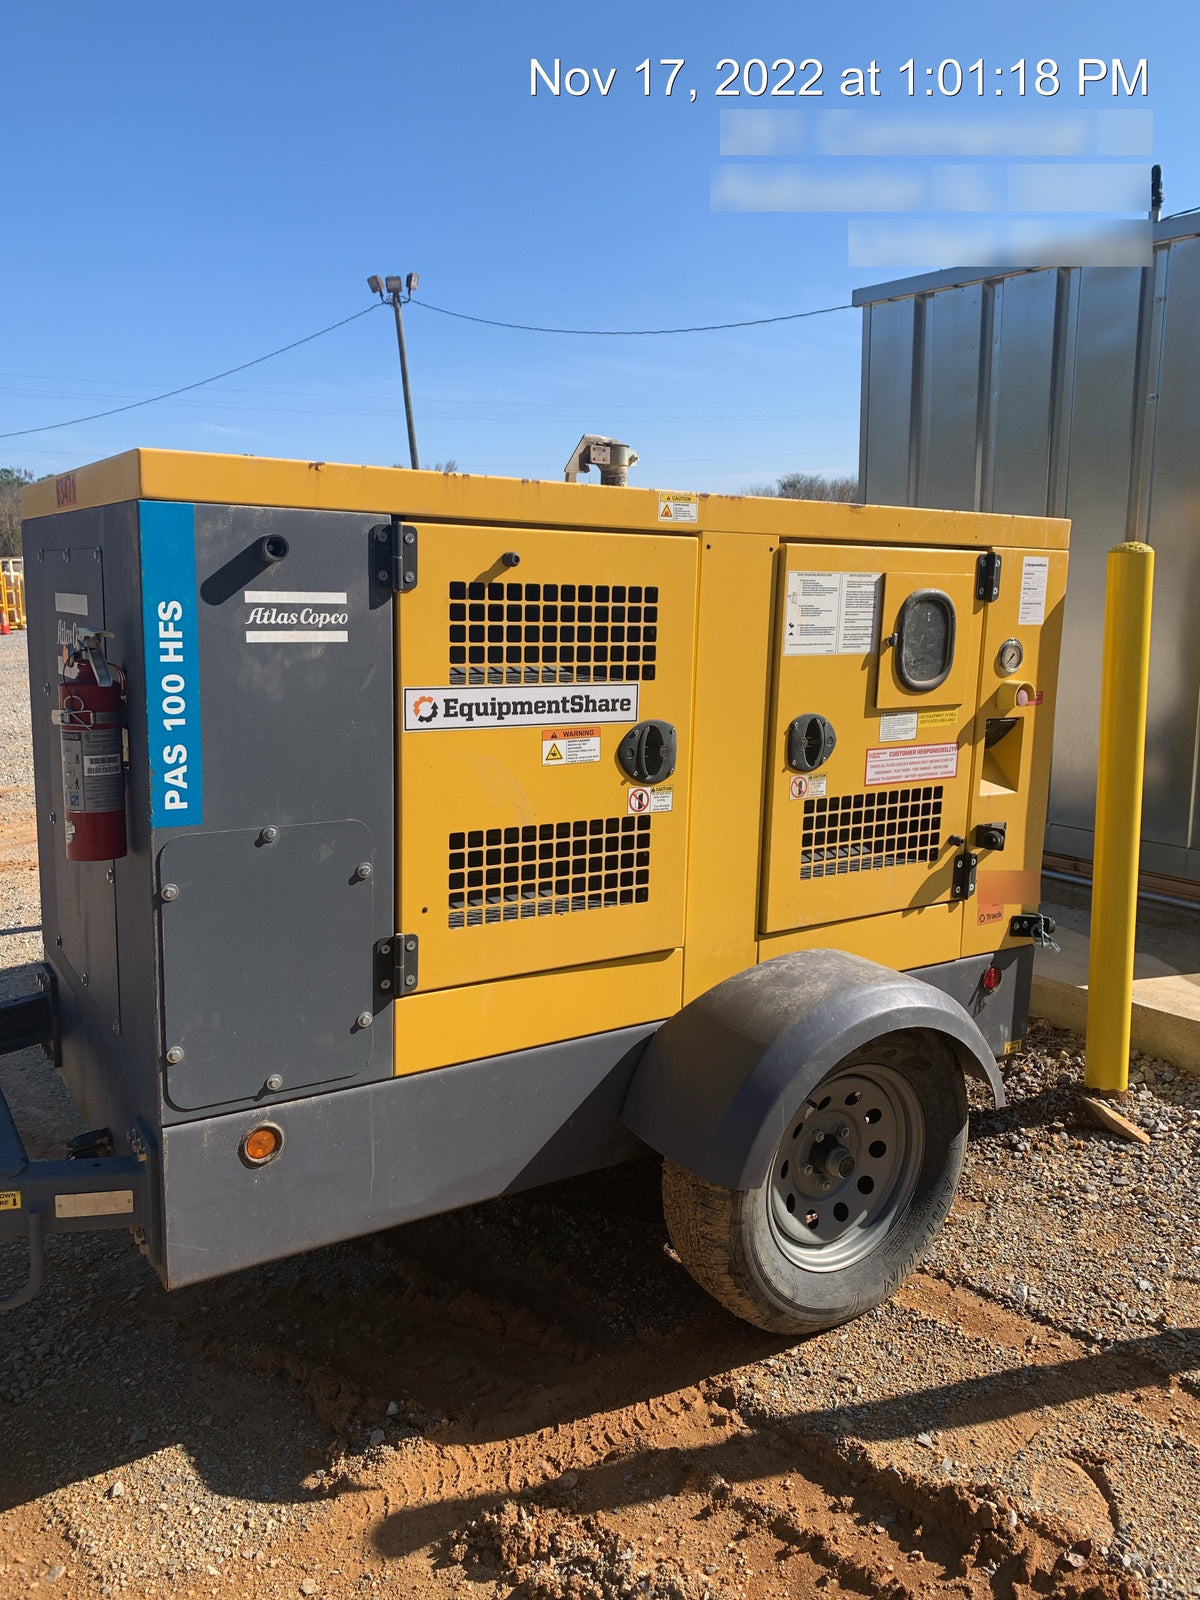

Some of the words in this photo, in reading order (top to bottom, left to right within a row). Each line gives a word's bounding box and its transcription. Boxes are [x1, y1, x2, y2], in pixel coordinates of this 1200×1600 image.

[245, 607, 298, 625] Atlas
[299, 607, 348, 628] Copco
[157, 600, 184, 663] HFS
[161, 673, 187, 731] 100
[443, 695, 632, 722] EquipmentShare
[562, 729, 595, 738] WARNING
[889, 749, 916, 757] CUSTOMER
[917, 747, 957, 755] RESPONSIBILITY
[163, 744, 189, 810] PAS
